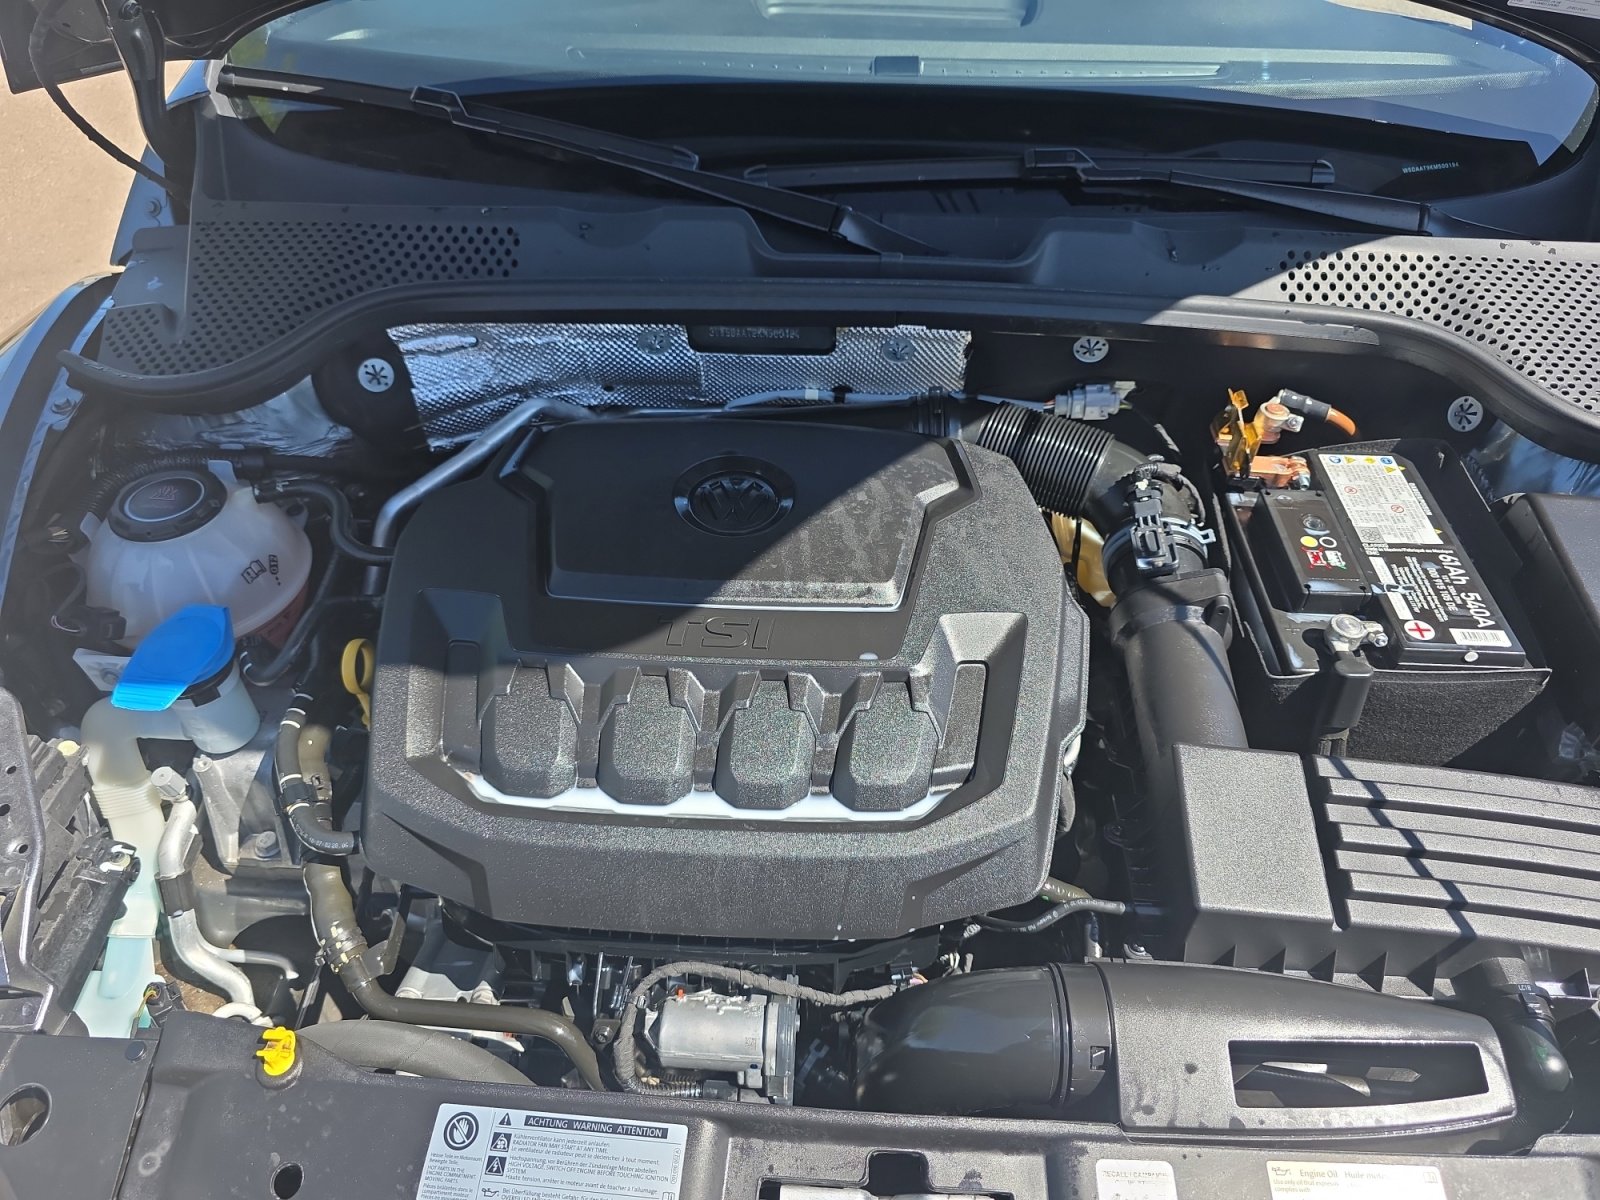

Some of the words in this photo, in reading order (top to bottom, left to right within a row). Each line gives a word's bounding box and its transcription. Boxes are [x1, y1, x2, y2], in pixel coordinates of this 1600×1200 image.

[1432, 579, 1447, 589] 915
[1436, 554, 1473, 584] 61Ah
[1458, 592, 1497, 628] 540A
[1438, 591, 1453, 601] 105
[1445, 602, 1459, 612] DE
[658, 616, 776, 650] TSI
[528, 1117, 568, 1128] ACHTUNG
[573, 1122, 613, 1132] WARNING
[617, 1126, 662, 1137] ATTENTION
[1300, 1169, 1325, 1179] Engine
[1344, 1171, 1364, 1179] Huile
